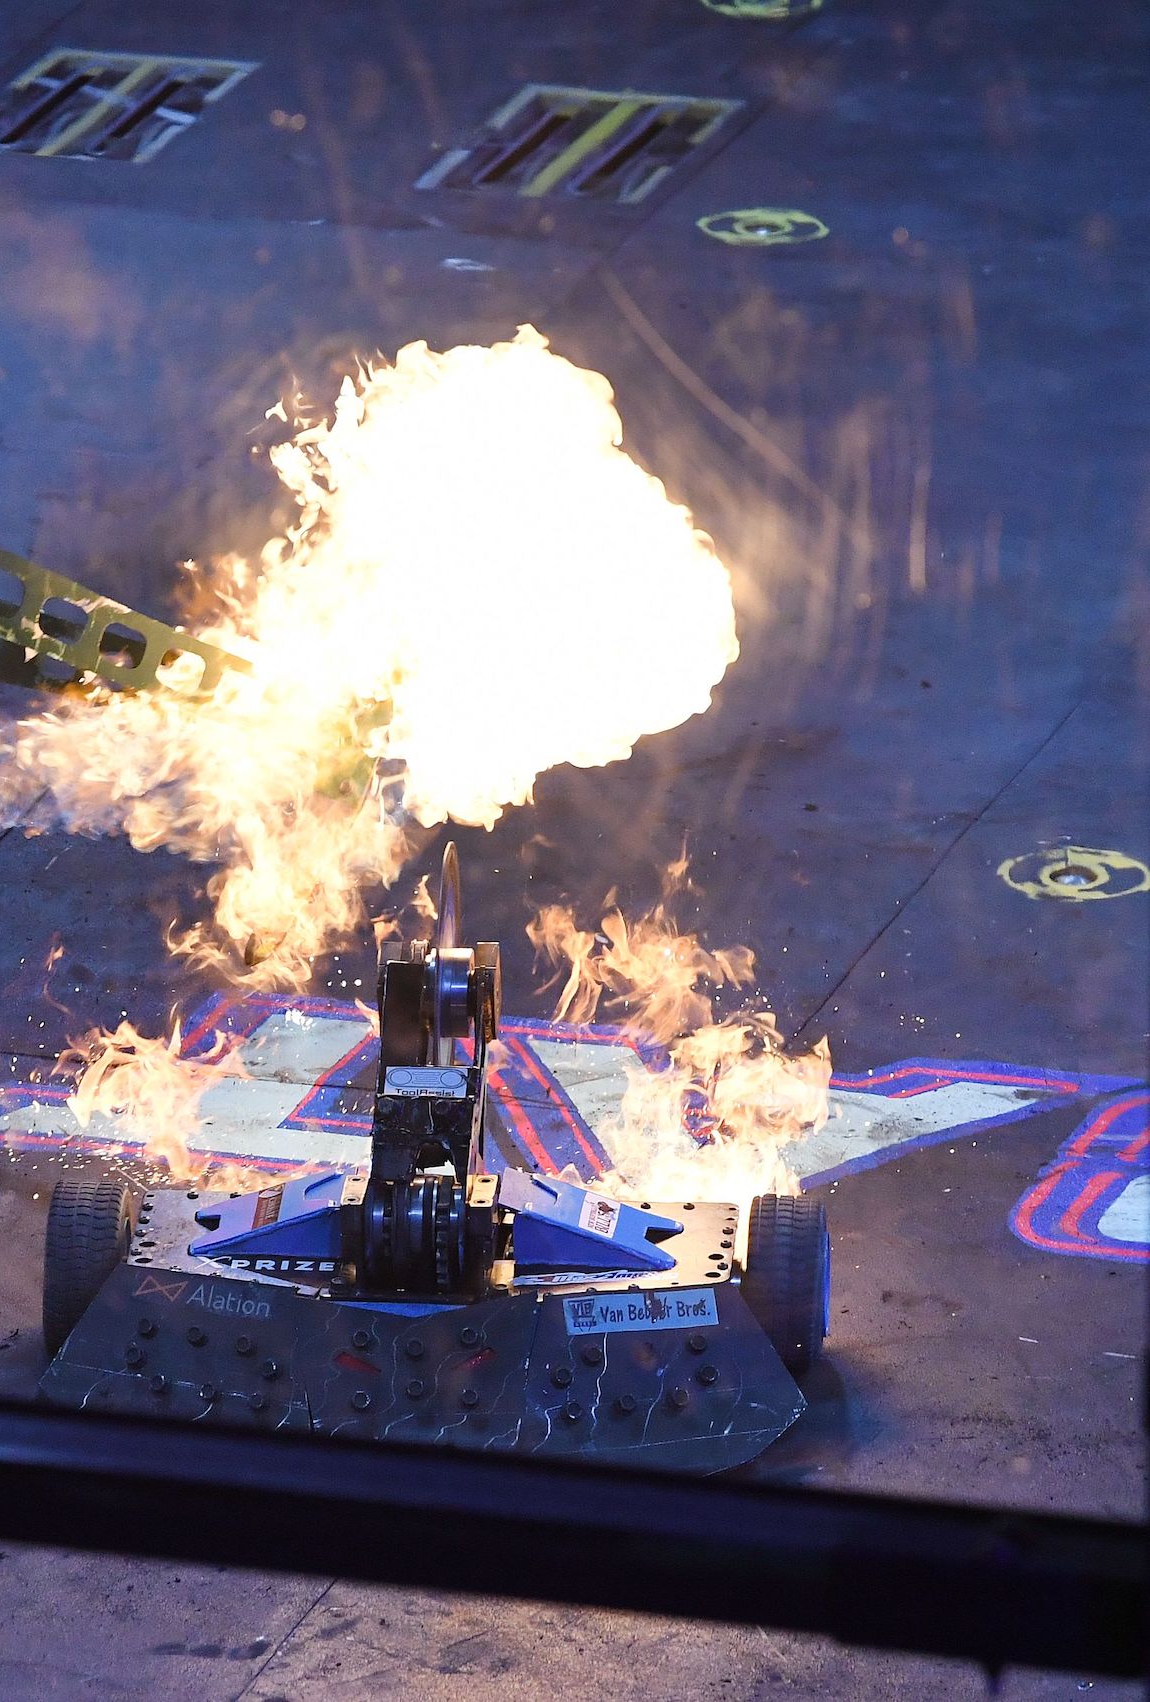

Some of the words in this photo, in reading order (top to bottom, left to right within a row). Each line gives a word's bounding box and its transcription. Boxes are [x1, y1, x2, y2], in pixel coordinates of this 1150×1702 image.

[195, 1256, 336, 1272] XPRIZE
[186, 1283, 271, 1318] Alation
[600, 1305, 624, 1323] Van
